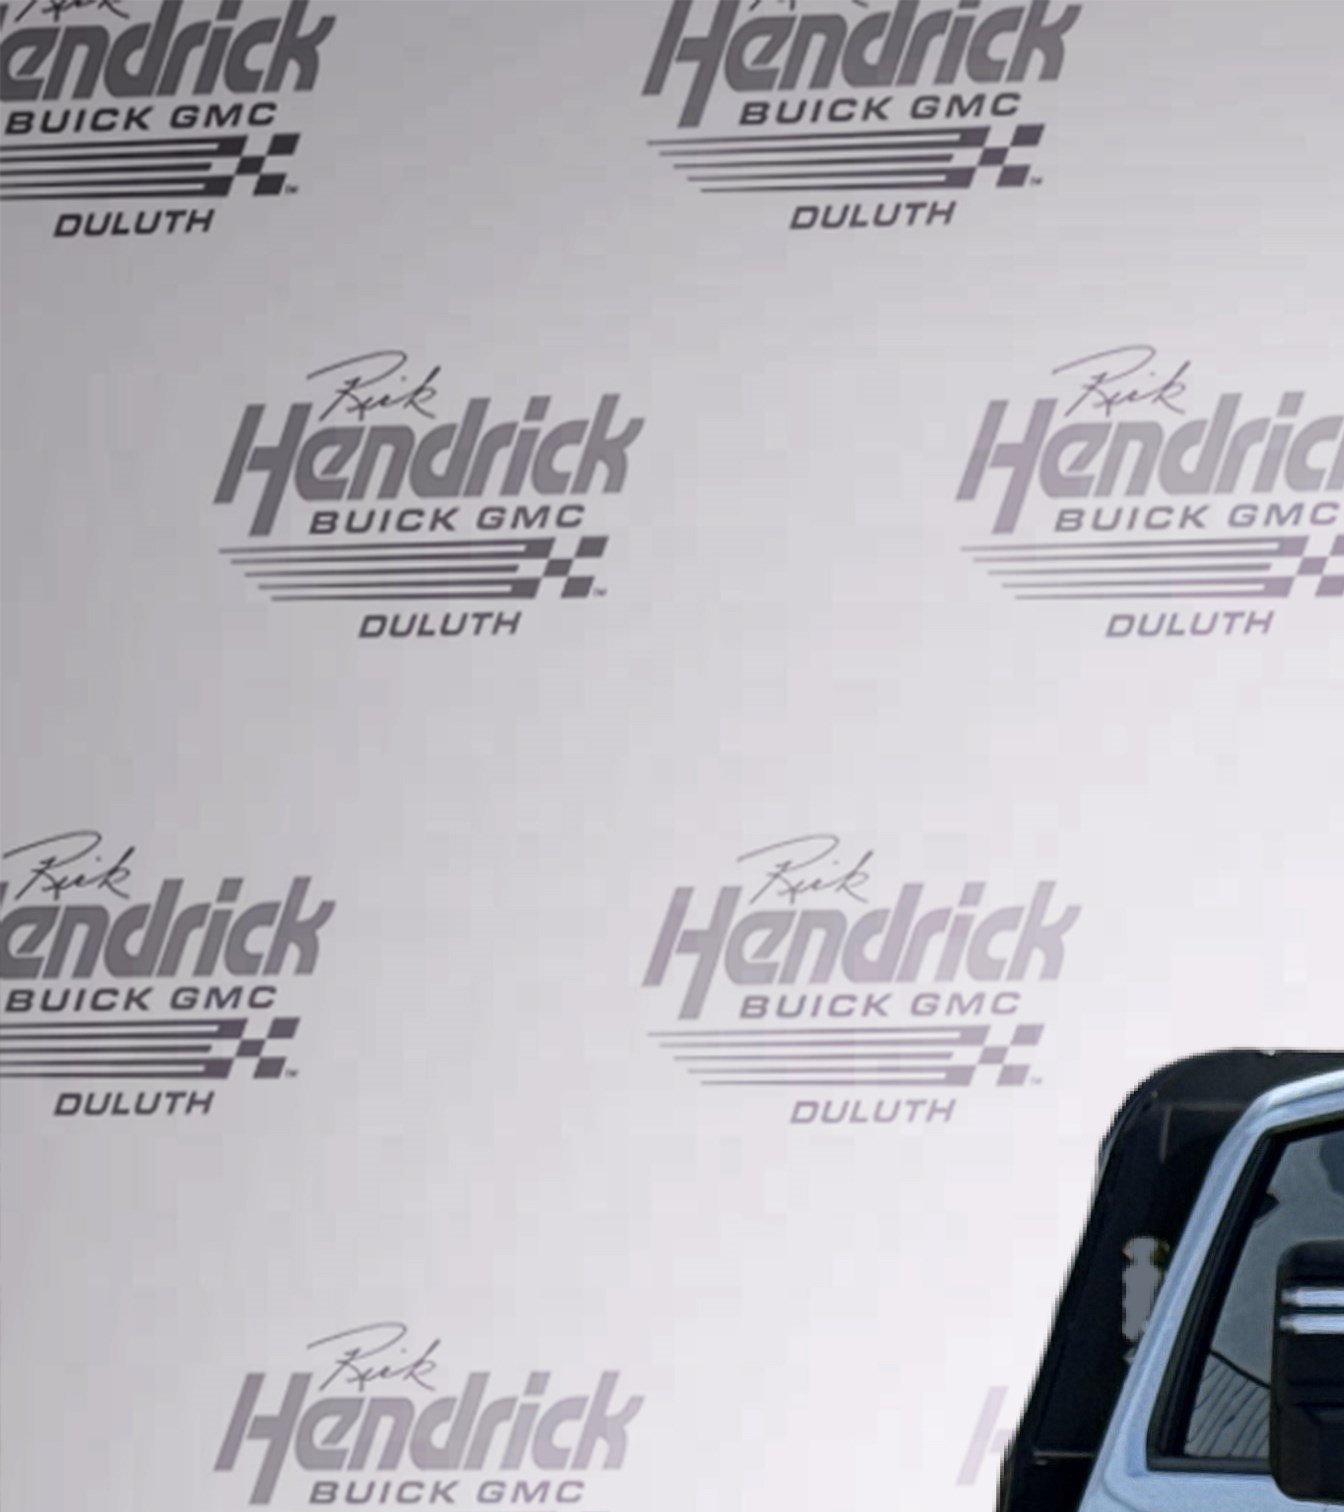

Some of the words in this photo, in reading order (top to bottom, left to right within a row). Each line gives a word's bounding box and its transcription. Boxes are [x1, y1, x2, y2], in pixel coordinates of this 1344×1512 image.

[0, 0, 336, 102] endrick
[5, 105, 153, 135] BUICK
[169, 102, 278, 129] GMC
[739, 96, 893, 126] BUICK
[910, 92, 1022, 120] GMC
[53, 208, 215, 237] DULUTH
[789, 201, 956, 230] DULUTH
[213, 393, 645, 537] Hendrick
[308, 507, 460, 536] BUICK
[475, 504, 586, 531] GMC
[1054, 505, 1210, 533] BUICK
[1227, 501, 1341, 527] GMC
[358, 612, 521, 638] DULUTH
[1105, 610, 1274, 638] DULUTH
[0, 876, 336, 979] endrick
[641, 880, 1082, 1021] Hendrick
[5, 986, 153, 1012] BUICK
[169, 986, 278, 1010] GMC
[739, 992, 892, 1019] BUICK
[910, 991, 1022, 1016] GMC
[53, 1090, 215, 1116] DULUTH
[789, 1098, 957, 1124] DULUTH
[213, 1370, 645, 1506] Hendrick
[308, 1480, 460, 1504] BUICK
[476, 1480, 586, 1504] GMC
